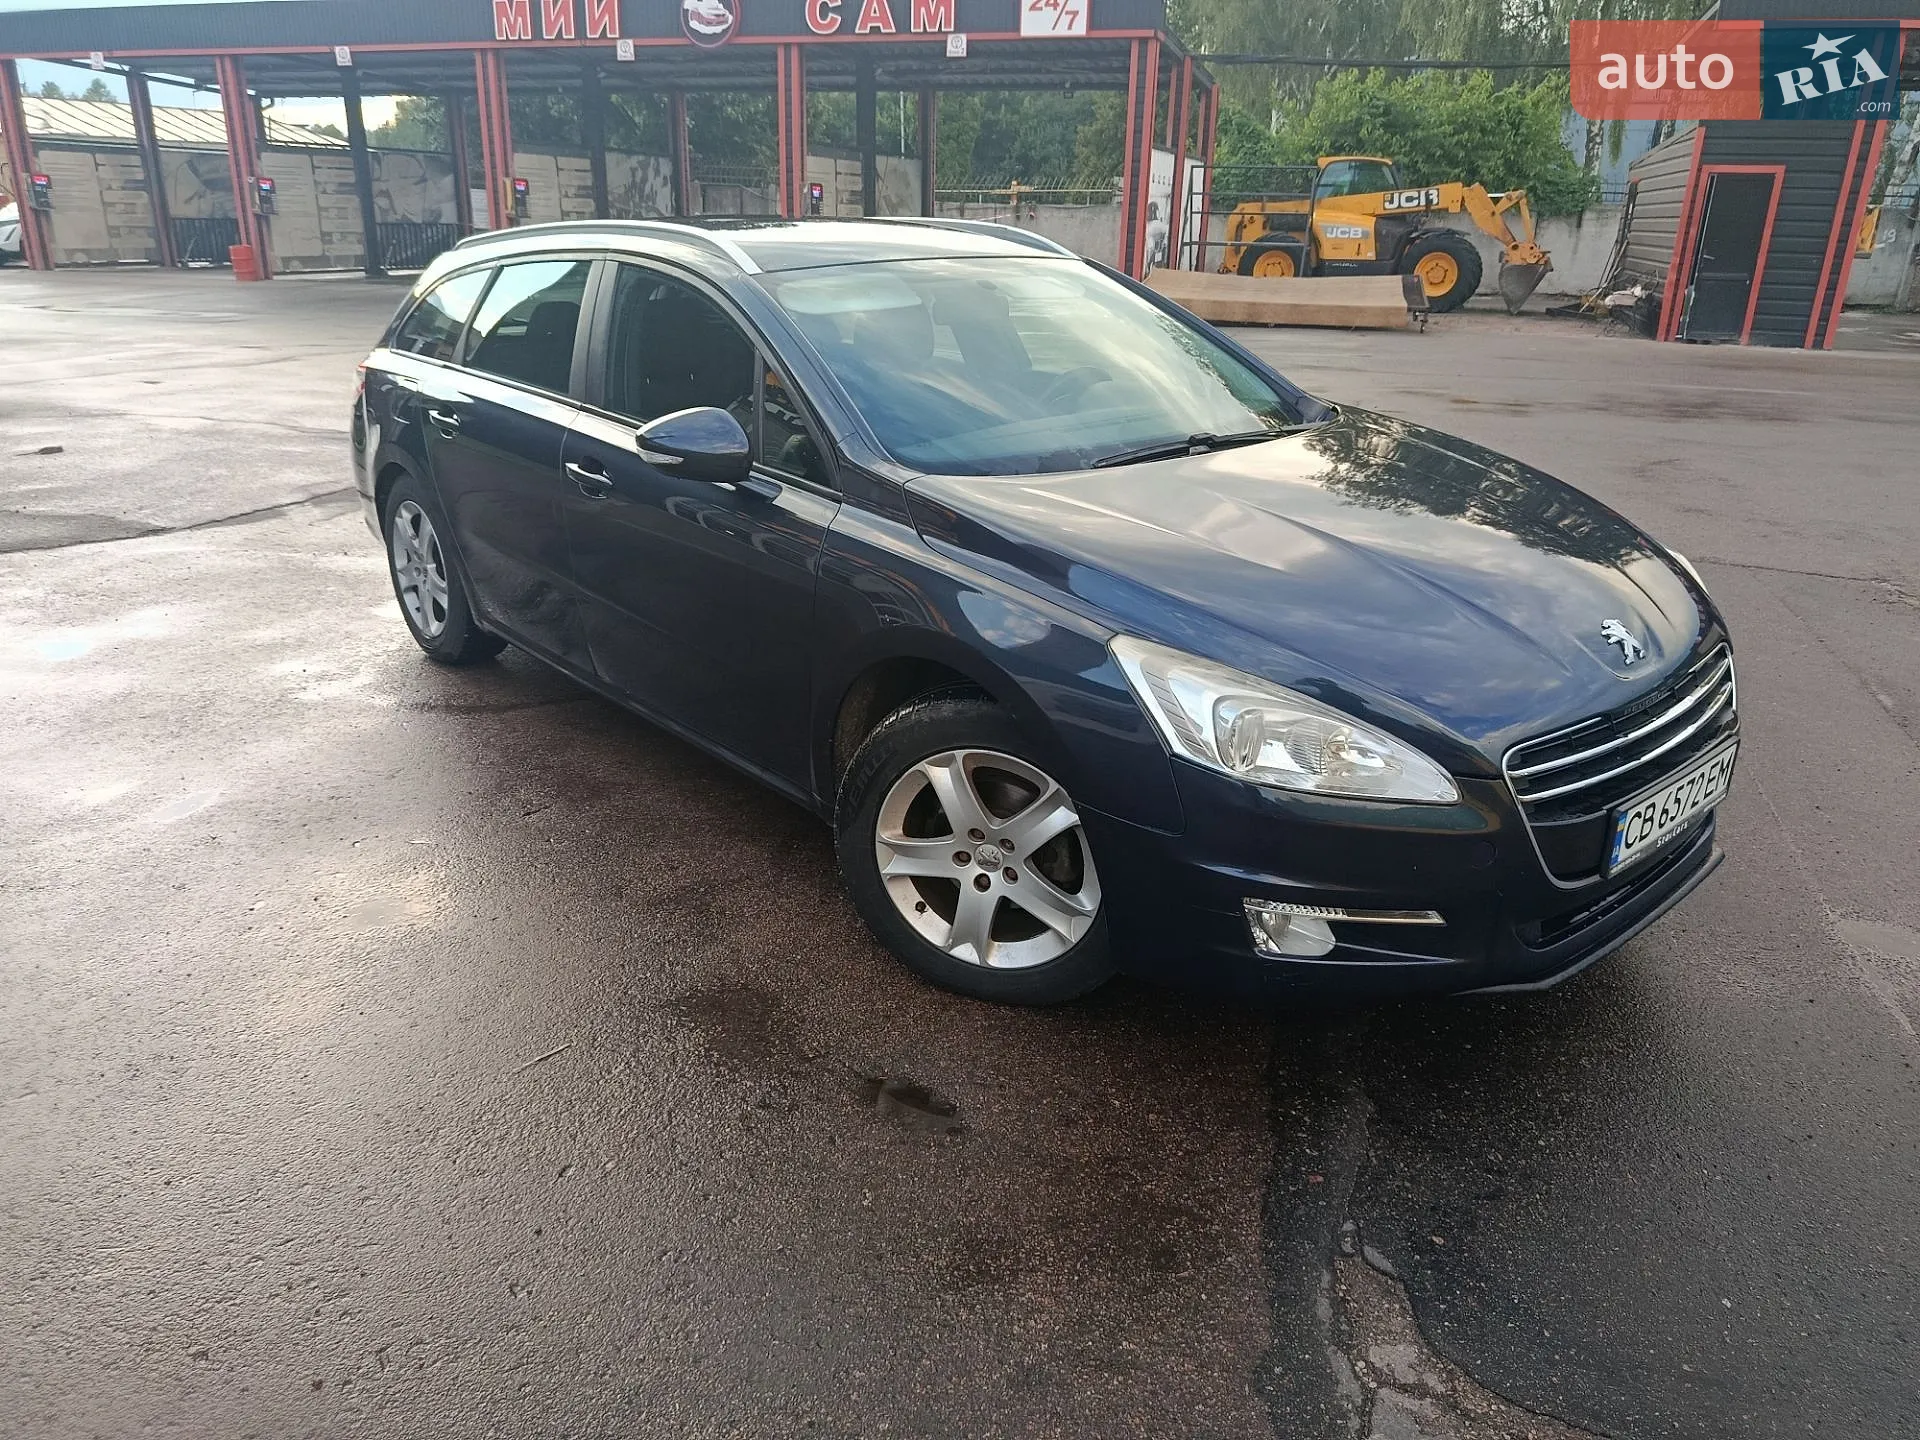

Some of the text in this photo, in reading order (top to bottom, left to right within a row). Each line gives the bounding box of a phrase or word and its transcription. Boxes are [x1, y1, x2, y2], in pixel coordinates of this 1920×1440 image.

[805, 0, 955, 34] САМ
[1384, 188, 1439, 210] JCB
[1326, 227, 1362, 239] JCB
[1624, 751, 1734, 850] CB 6572 EM
